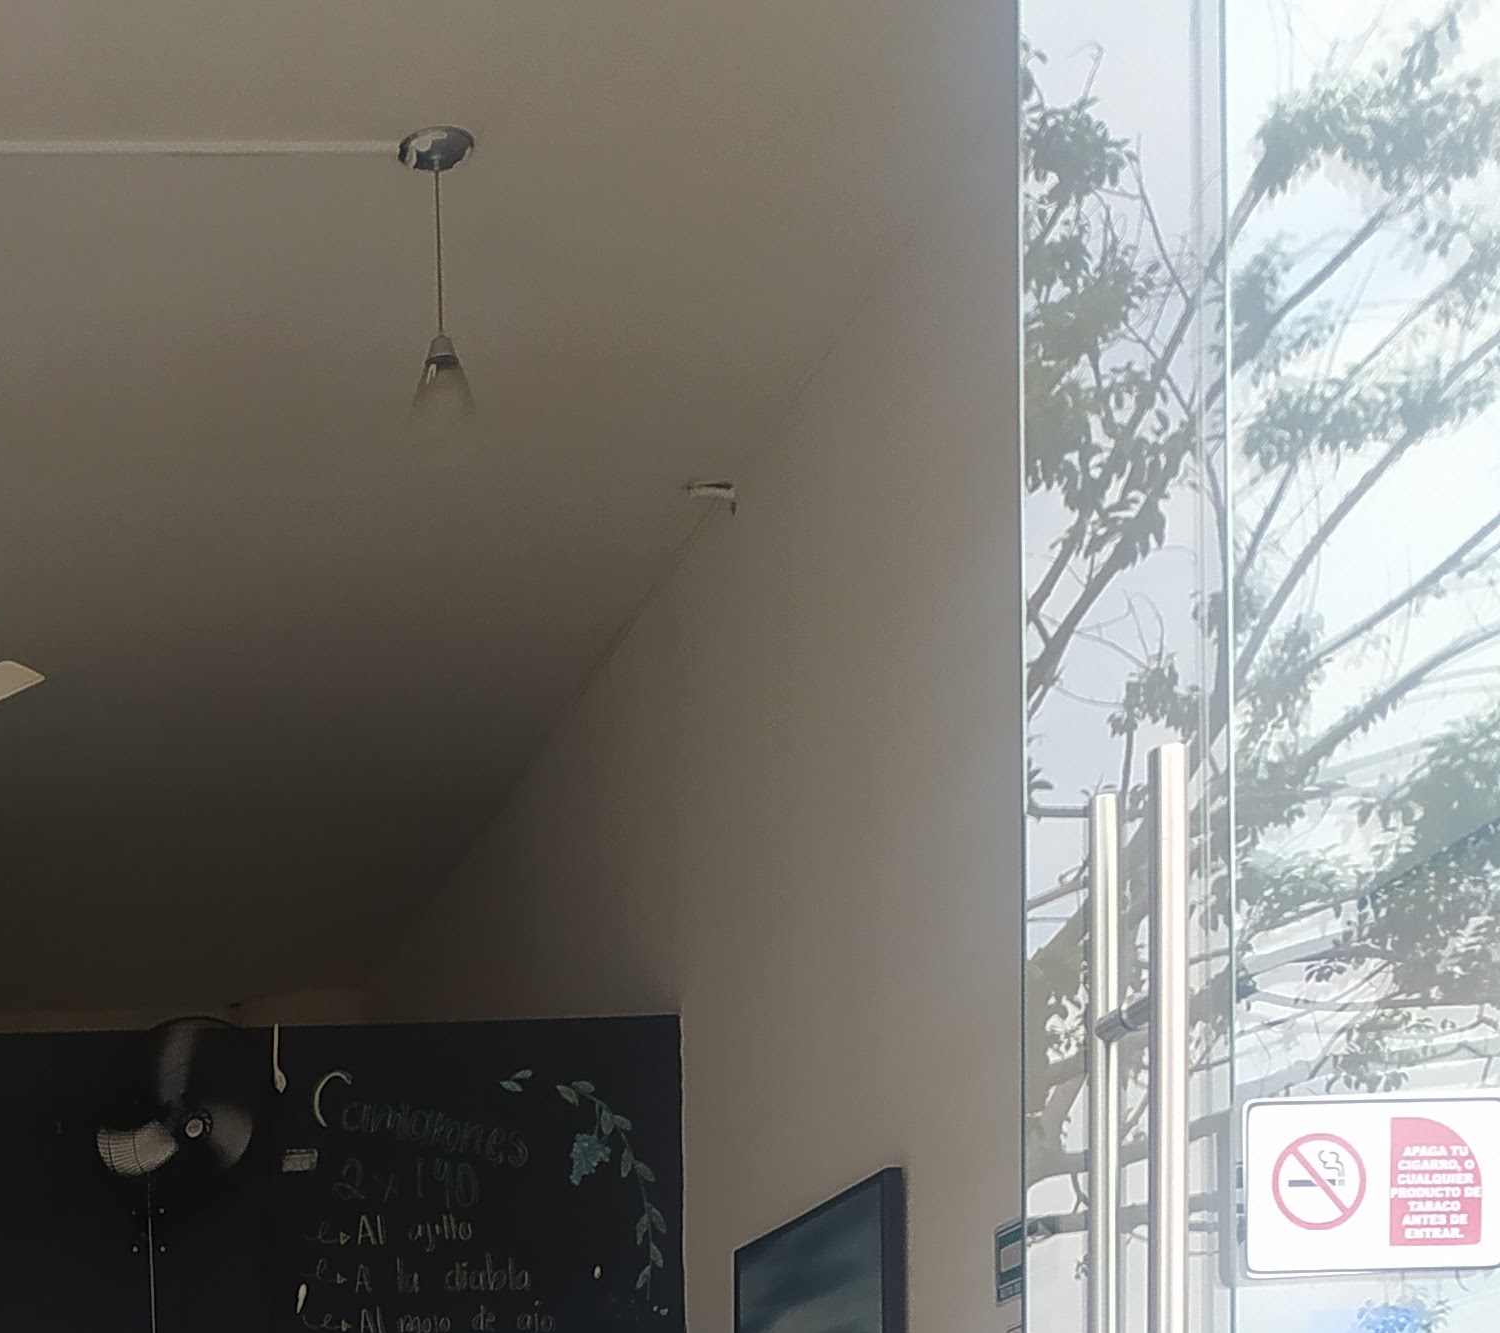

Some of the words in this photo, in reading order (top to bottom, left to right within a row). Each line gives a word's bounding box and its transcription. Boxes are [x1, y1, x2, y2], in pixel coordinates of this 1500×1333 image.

[1401, 1146, 1448, 1157] APAGA
[1449, 1145, 1469, 1157] TU
[1463, 1159, 1475, 1171] O
[1396, 1173, 1474, 1185] CUALQUIER
[1390, 1187, 1461, 1199] PRODUCTO
[1463, 1186, 1482, 1198] DE
[1407, 1200, 1461, 1212] TABACO
[1401, 1214, 1447, 1226] ANTES
[1449, 1213, 1469, 1225] DE
[356, 1214, 388, 1246] Al
[1403, 1227, 1465, 1239] ENTRAR.
[354, 1263, 374, 1295] A
[395, 1255, 421, 1296] la
[443, 1250, 531, 1294] diabla
